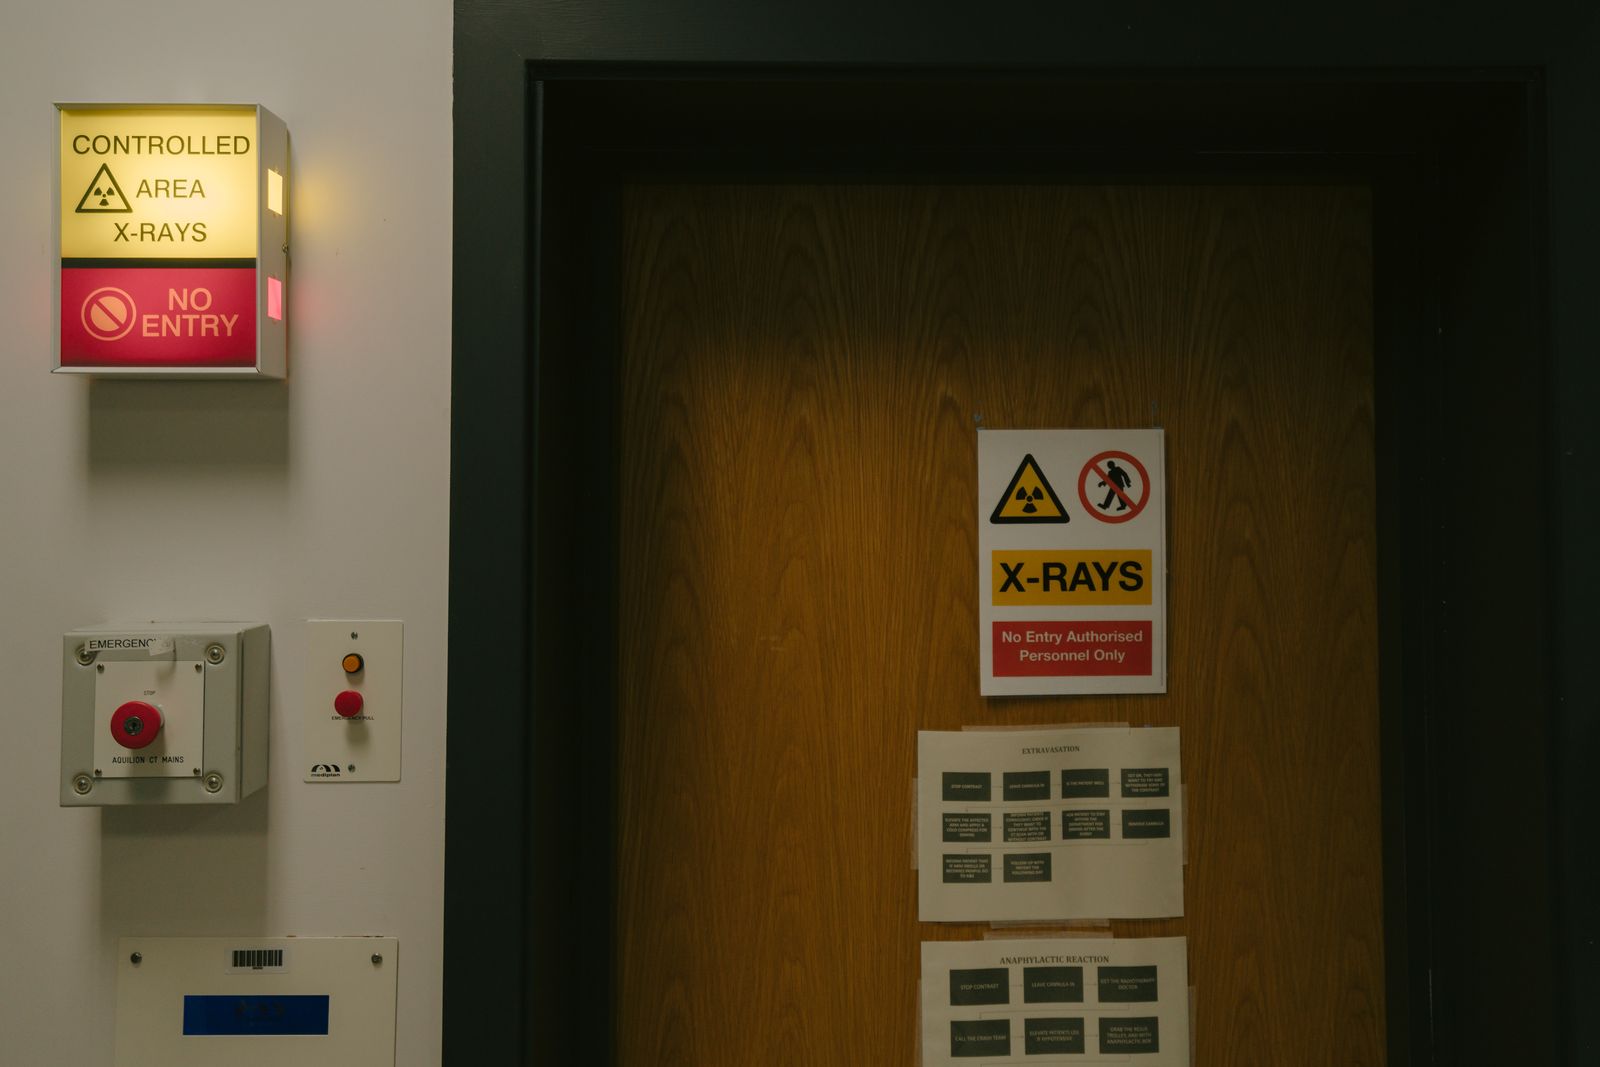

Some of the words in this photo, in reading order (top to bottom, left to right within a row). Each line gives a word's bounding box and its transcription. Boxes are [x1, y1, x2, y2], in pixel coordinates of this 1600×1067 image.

[72, 134, 250, 156] CONTROLLED
[136, 179, 206, 199] AREA
[113, 222, 208, 242] X-RAYS
[168, 287, 213, 312] NO
[142, 314, 239, 337] ENTRY
[999, 561, 1144, 592] X-RAYS
[1002, 631, 1022, 644] No
[1026, 631, 1062, 646] Entry
[1066, 630, 1143, 643] Authorised
[1019, 649, 1090, 662] Personnel
[1094, 649, 1126, 663] Only
[112, 756, 145, 764] AQUILION
[149, 755, 158, 764] CT
[161, 755, 184, 763] MAINS
[1022, 745, 1080, 755] EXTRAVASATION
[1000, 955, 1064, 964] ANAPHYLACTIC
[1066, 955, 1110, 963] REACTION
